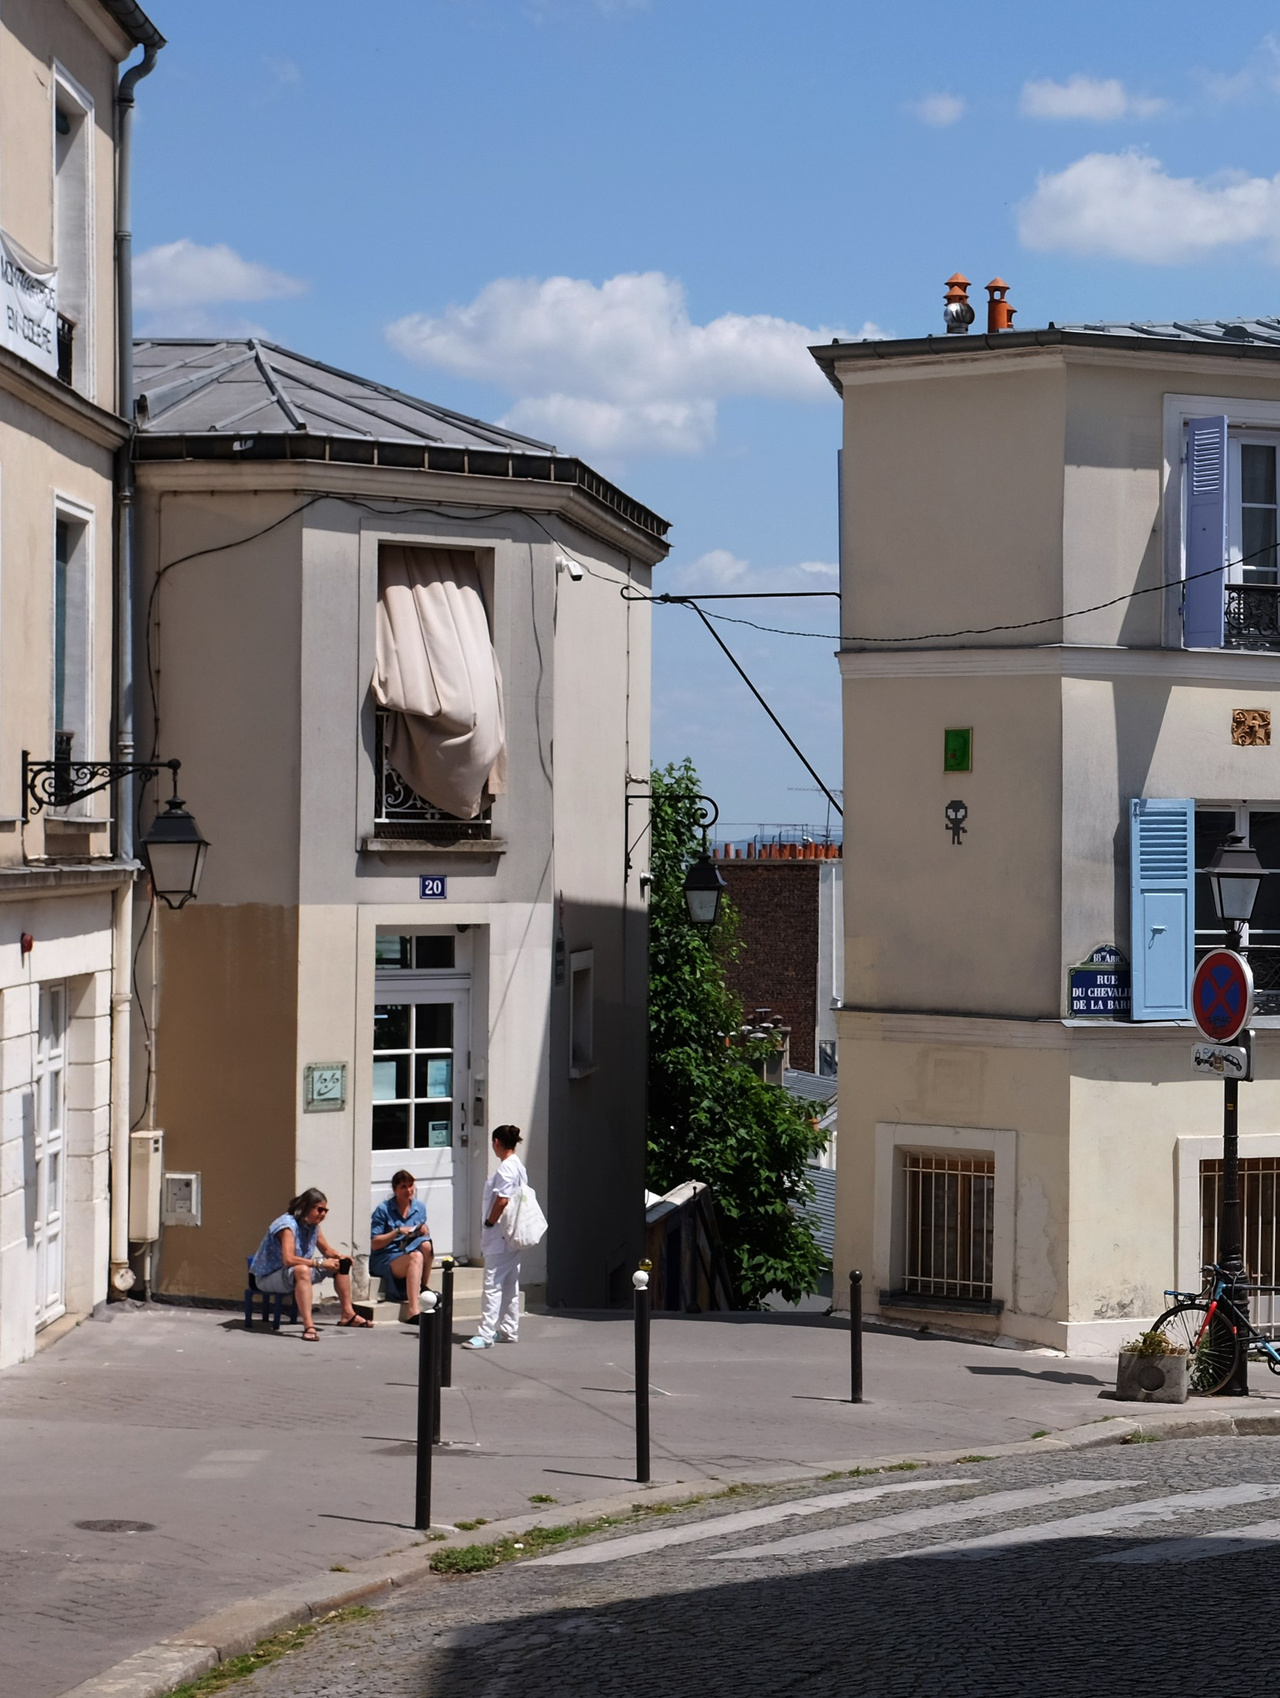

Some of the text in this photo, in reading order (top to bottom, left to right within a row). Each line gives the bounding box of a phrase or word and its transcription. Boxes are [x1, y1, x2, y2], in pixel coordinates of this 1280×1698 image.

[425, 880, 442, 895] 20
[1096, 975, 1118, 985] RUE
[1072, 987, 1086, 997] DU
[1073, 1000, 1087, 1010] DE
[1090, 1000, 1104, 1010] LA
